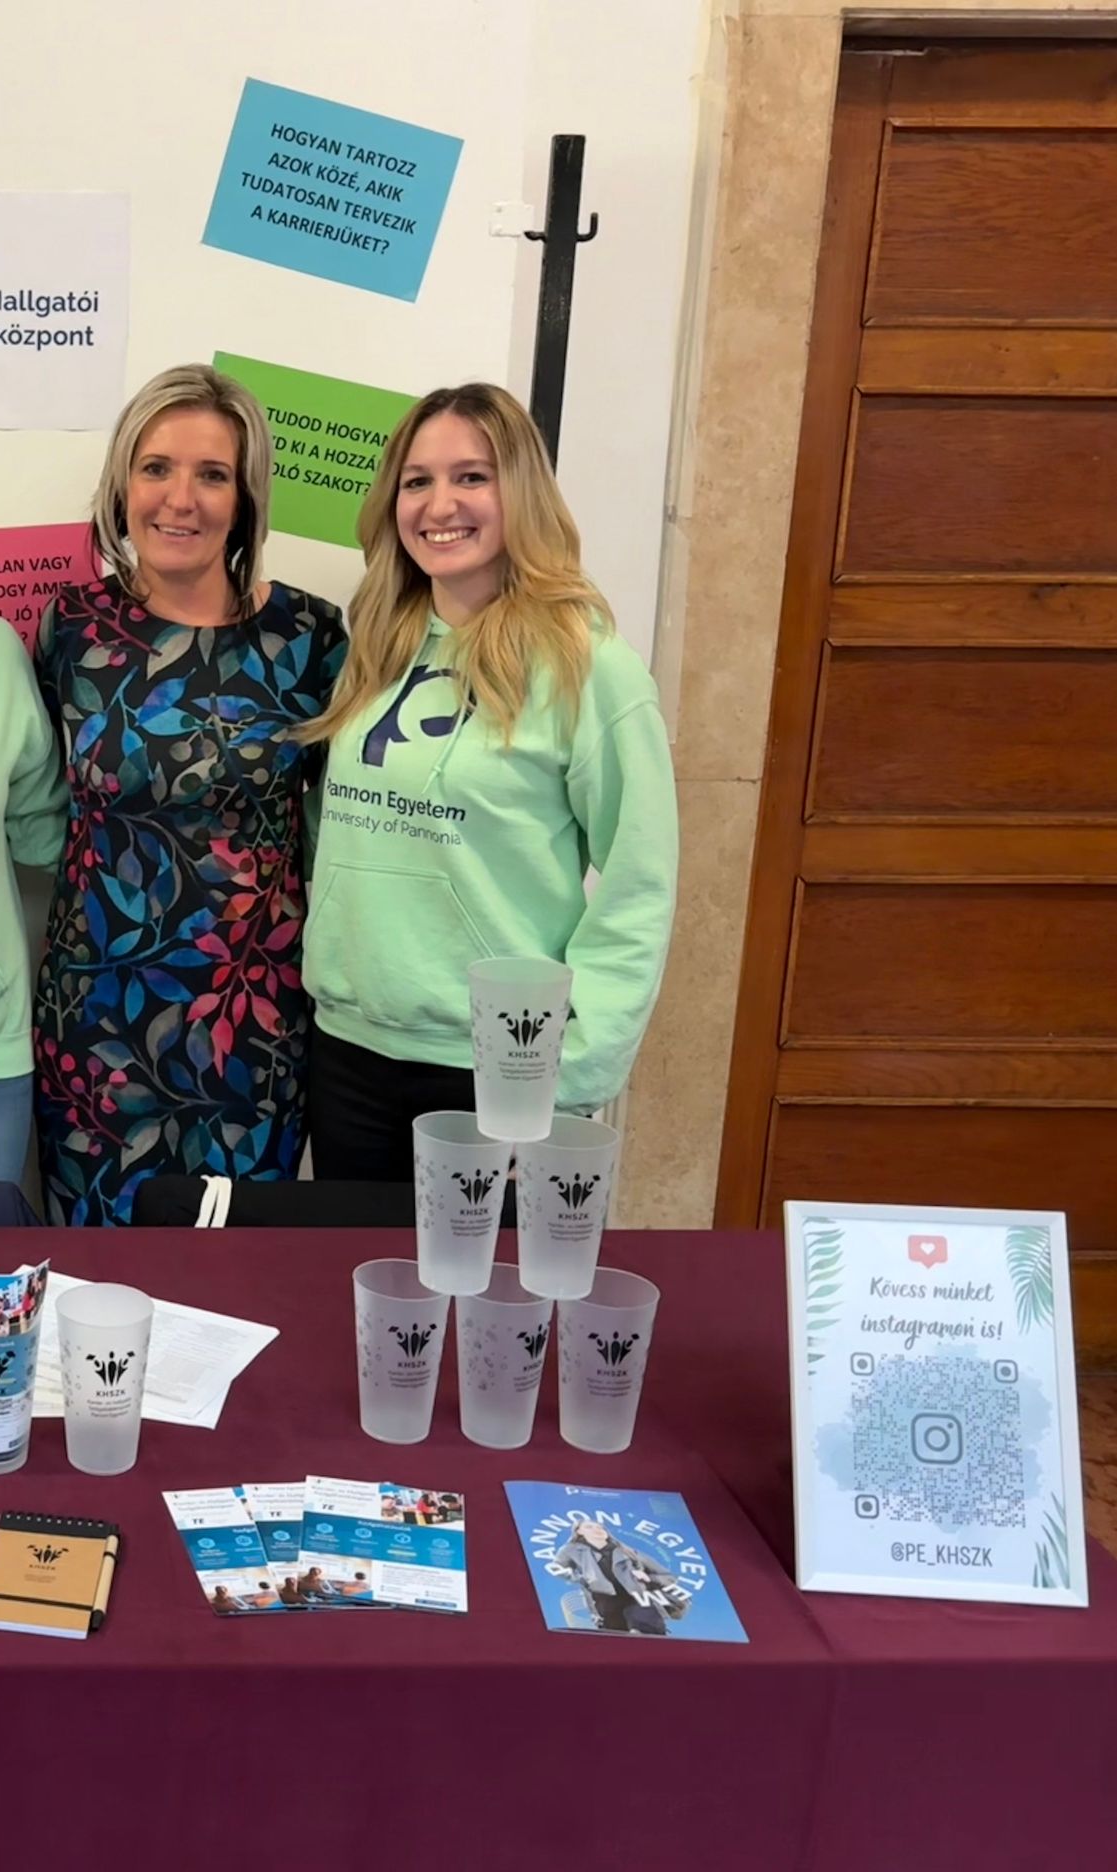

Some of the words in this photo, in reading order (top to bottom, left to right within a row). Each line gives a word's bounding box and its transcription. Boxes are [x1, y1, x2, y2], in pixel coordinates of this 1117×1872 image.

[270, 122, 343, 156] HOGYAN
[345, 143, 418, 178] TARTOZZ
[267, 152, 312, 177] AZOK
[316, 165, 361, 193] KÖZÉ,
[364, 179, 404, 203] AKIK
[240, 171, 340, 213] TUDATOSAN
[343, 200, 418, 235] TERVEZIK
[250, 204, 263, 221] A
[266, 208, 391, 256] KARRIERJÜKET?
[266, 406, 323, 432] TUDOD
[290, 440, 306, 455] KI
[308, 445, 319, 459] A
[324, 448, 381, 472] HOZZÁ
[29, 556, 72, 571] VAGY
[14, 604, 32, 621] JÓ
[387, 790, 466, 821] Egyetem
[383, 819, 398, 833] of
[401, 821, 461, 845] Pannonia
[933, 1282, 995, 1303] minket
[860, 1312, 976, 1350] instagramon
[980, 1320, 1004, 1340] is!
[890, 1542, 993, 1567] @PE_KHSZK
